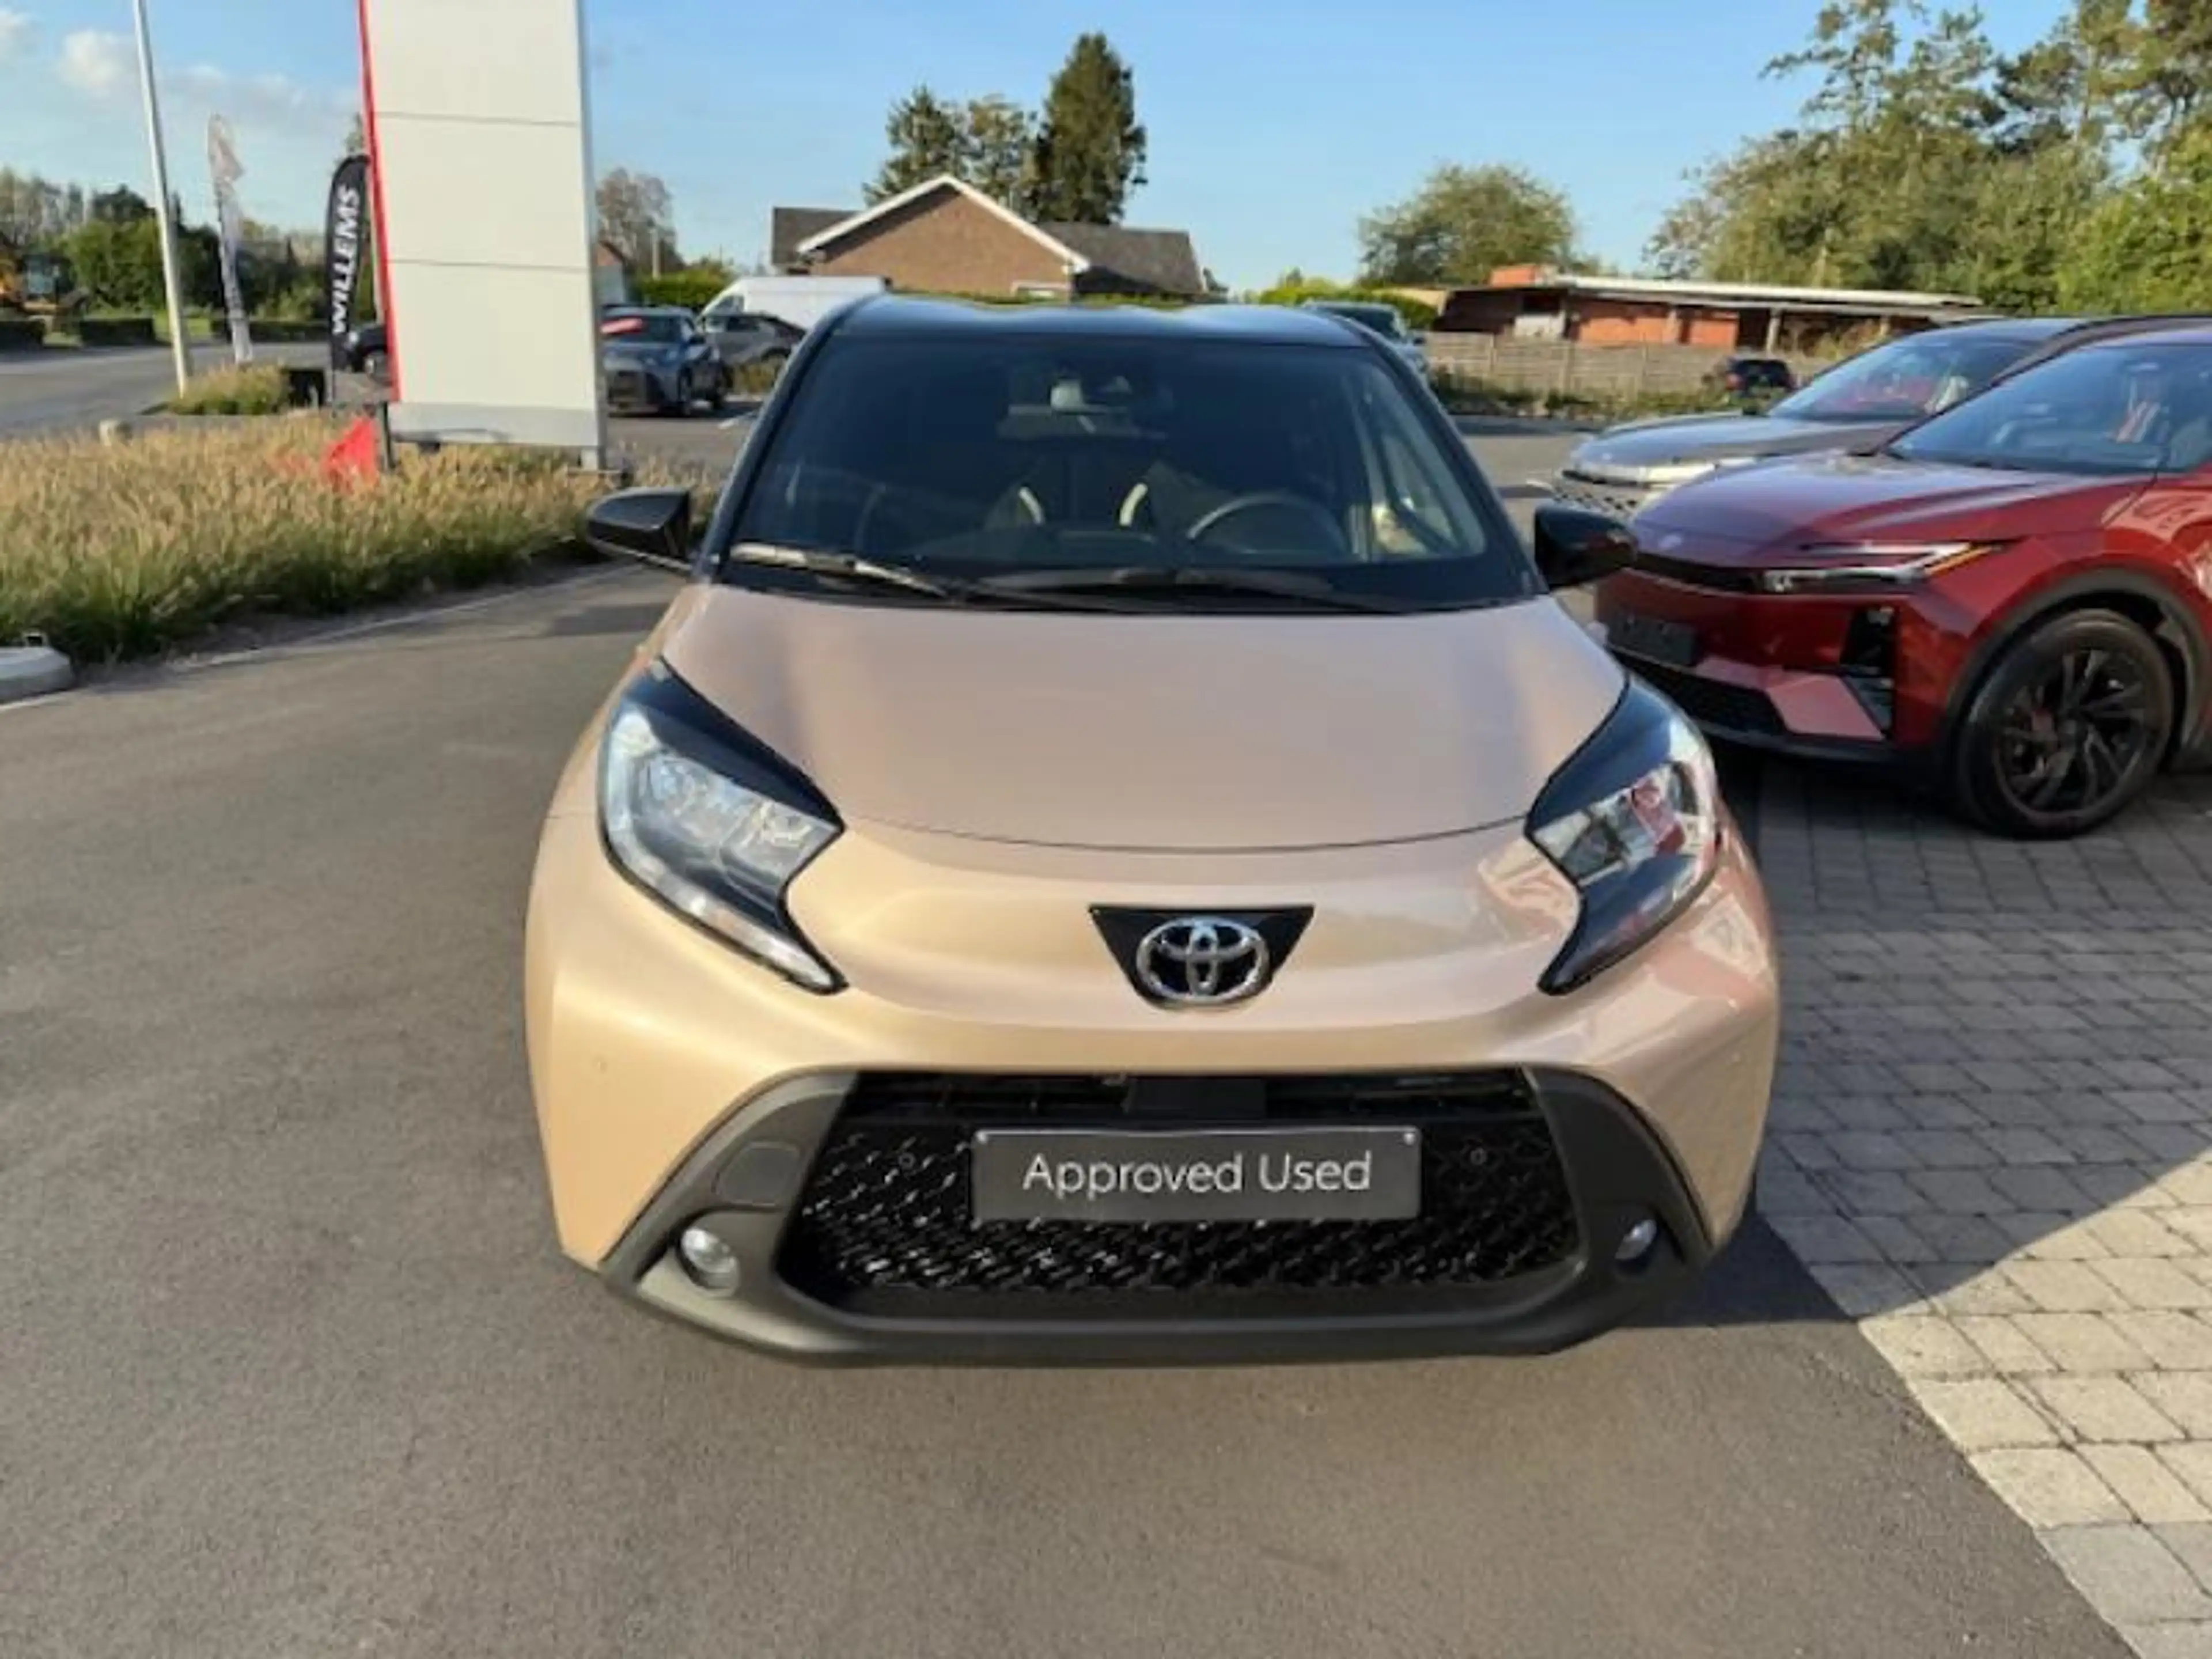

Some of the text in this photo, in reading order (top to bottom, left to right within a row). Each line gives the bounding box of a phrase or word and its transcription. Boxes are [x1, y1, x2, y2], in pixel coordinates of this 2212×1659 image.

[332, 183, 359, 334] WILLEMS
[1022, 1151, 1372, 1199] Approved Used
